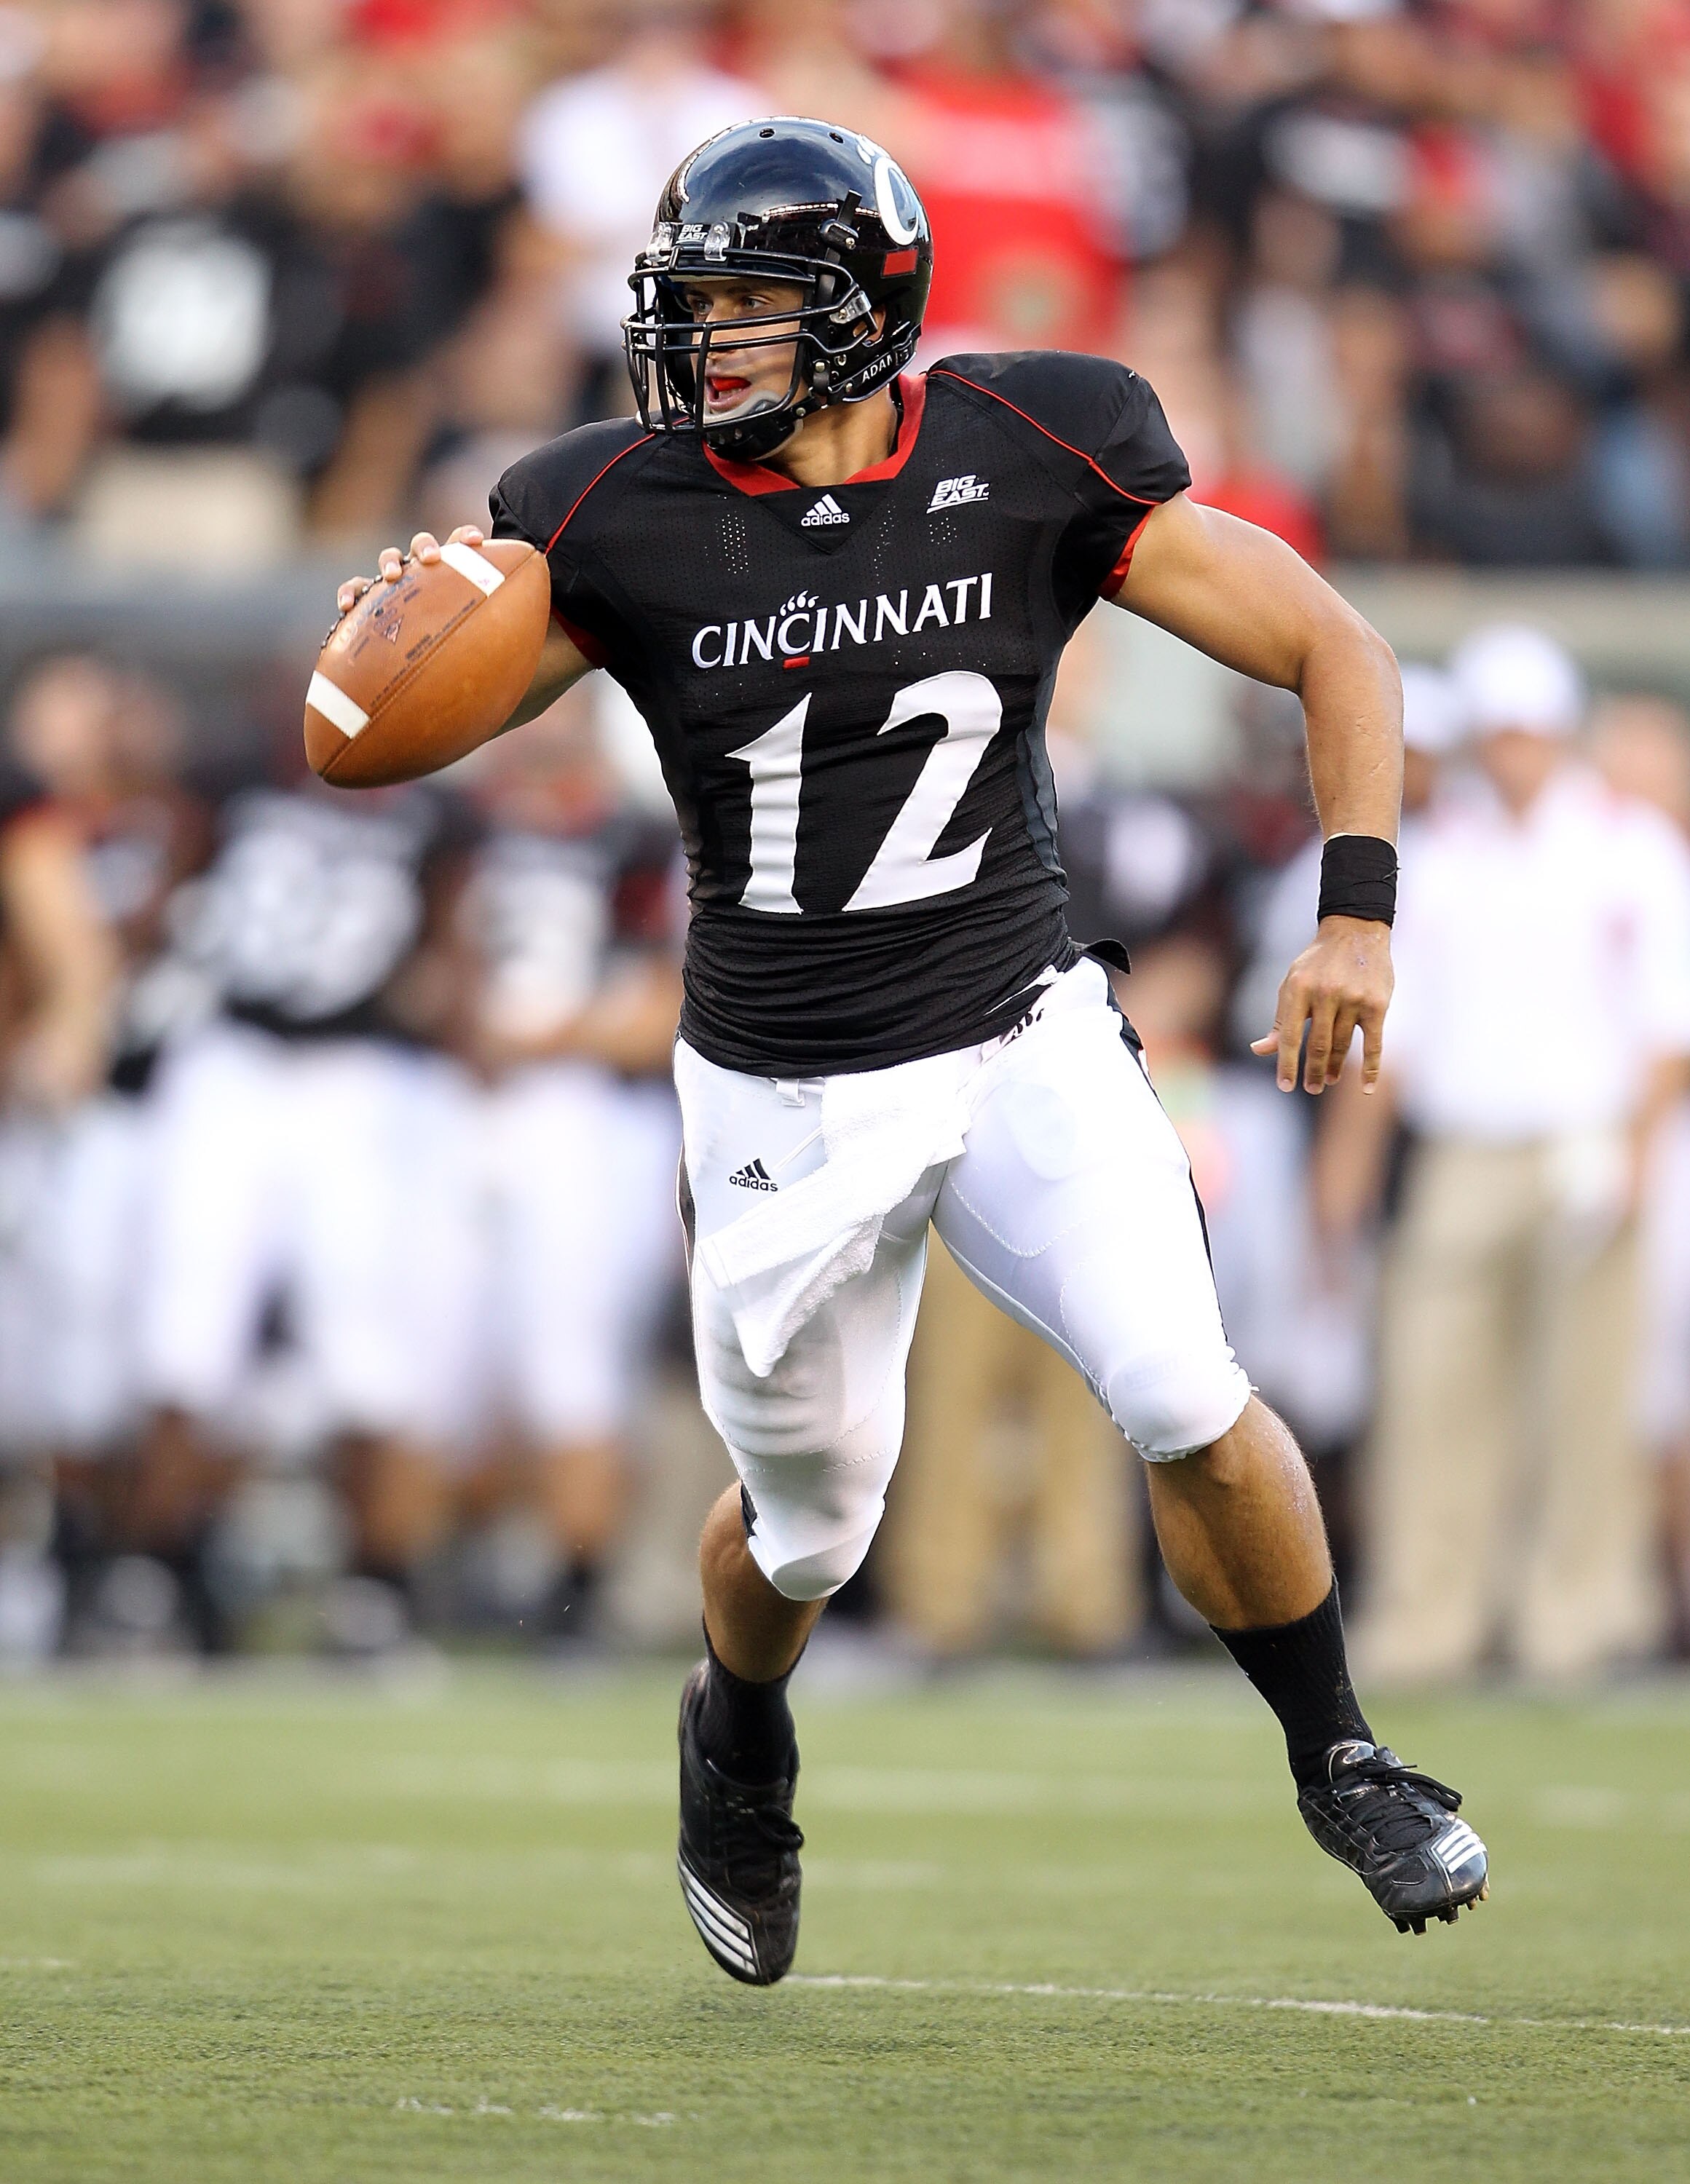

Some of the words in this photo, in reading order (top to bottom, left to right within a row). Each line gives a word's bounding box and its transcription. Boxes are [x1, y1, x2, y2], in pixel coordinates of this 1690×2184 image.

[678, 232, 708, 240] EAST
[682, 224, 703, 233] BIG
[935, 475, 976, 494] BIG
[931, 483, 989, 507] EAST
[801, 513, 850, 526] adidas
[692, 572, 992, 668] CINCINNATI
[724, 670, 1003, 914] 12
[729, 1176, 778, 1192] adidas
